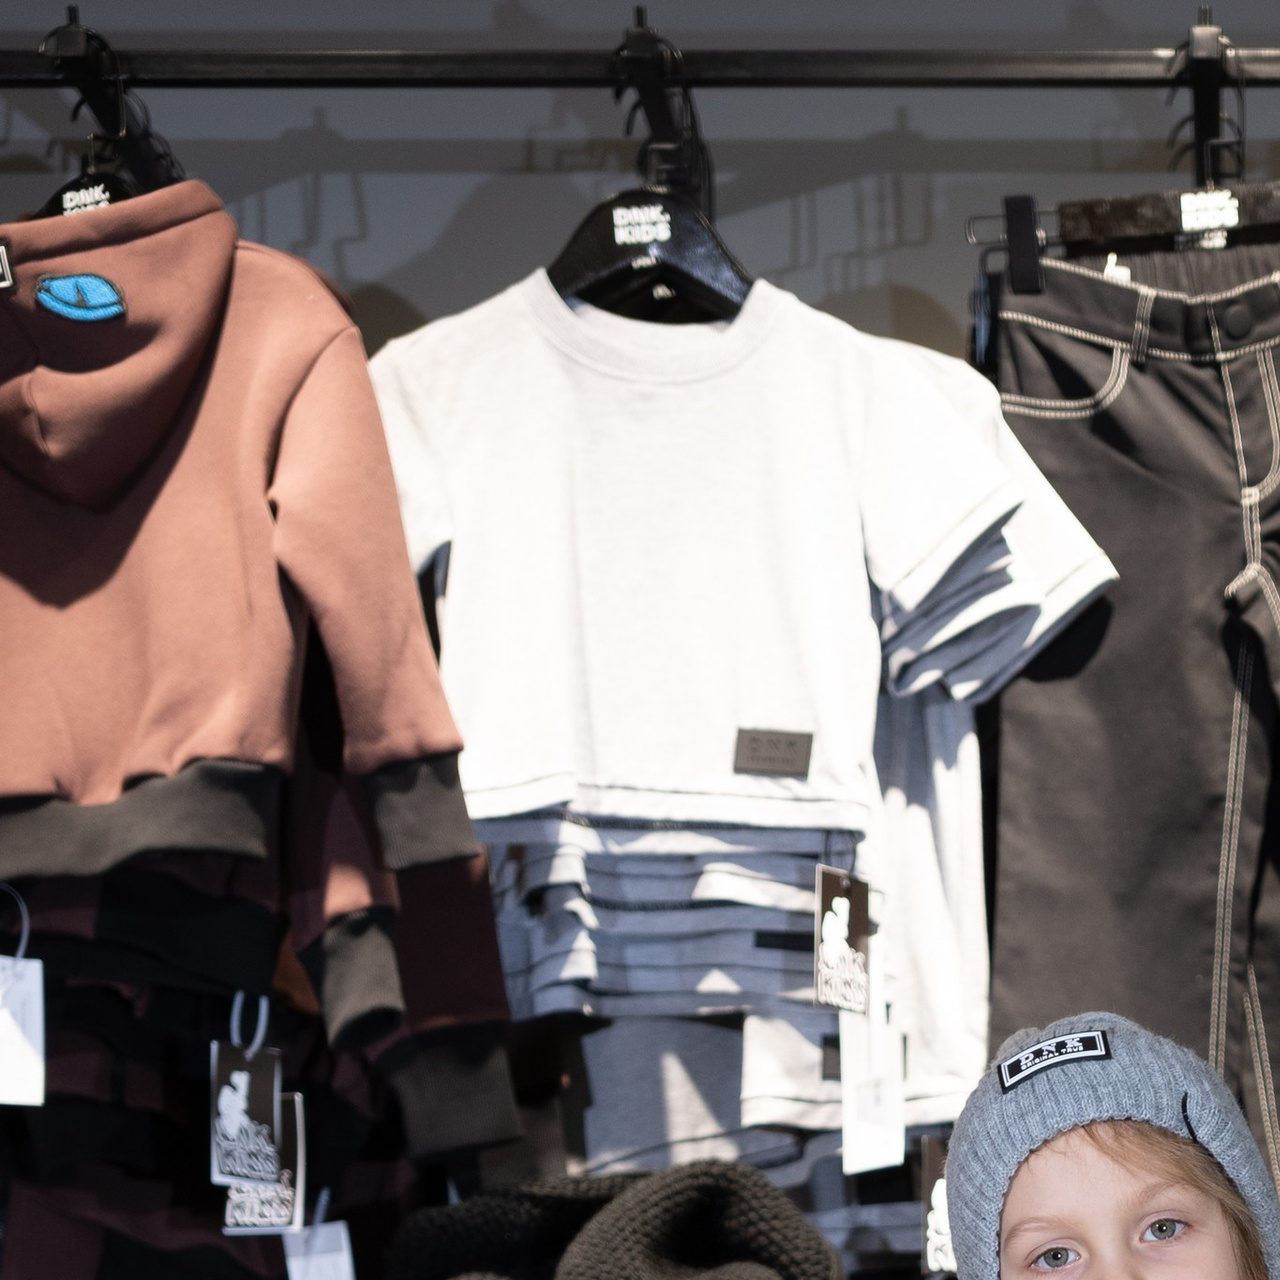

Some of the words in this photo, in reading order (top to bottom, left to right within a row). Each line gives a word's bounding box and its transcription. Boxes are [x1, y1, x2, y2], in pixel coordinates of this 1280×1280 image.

[614, 222, 671, 245] KIDS
[1019, 1037, 1083, 1067] DNK
[1020, 1051, 1060, 1071] ORIGINAL
[1060, 1045, 1084, 1054] TRUE
